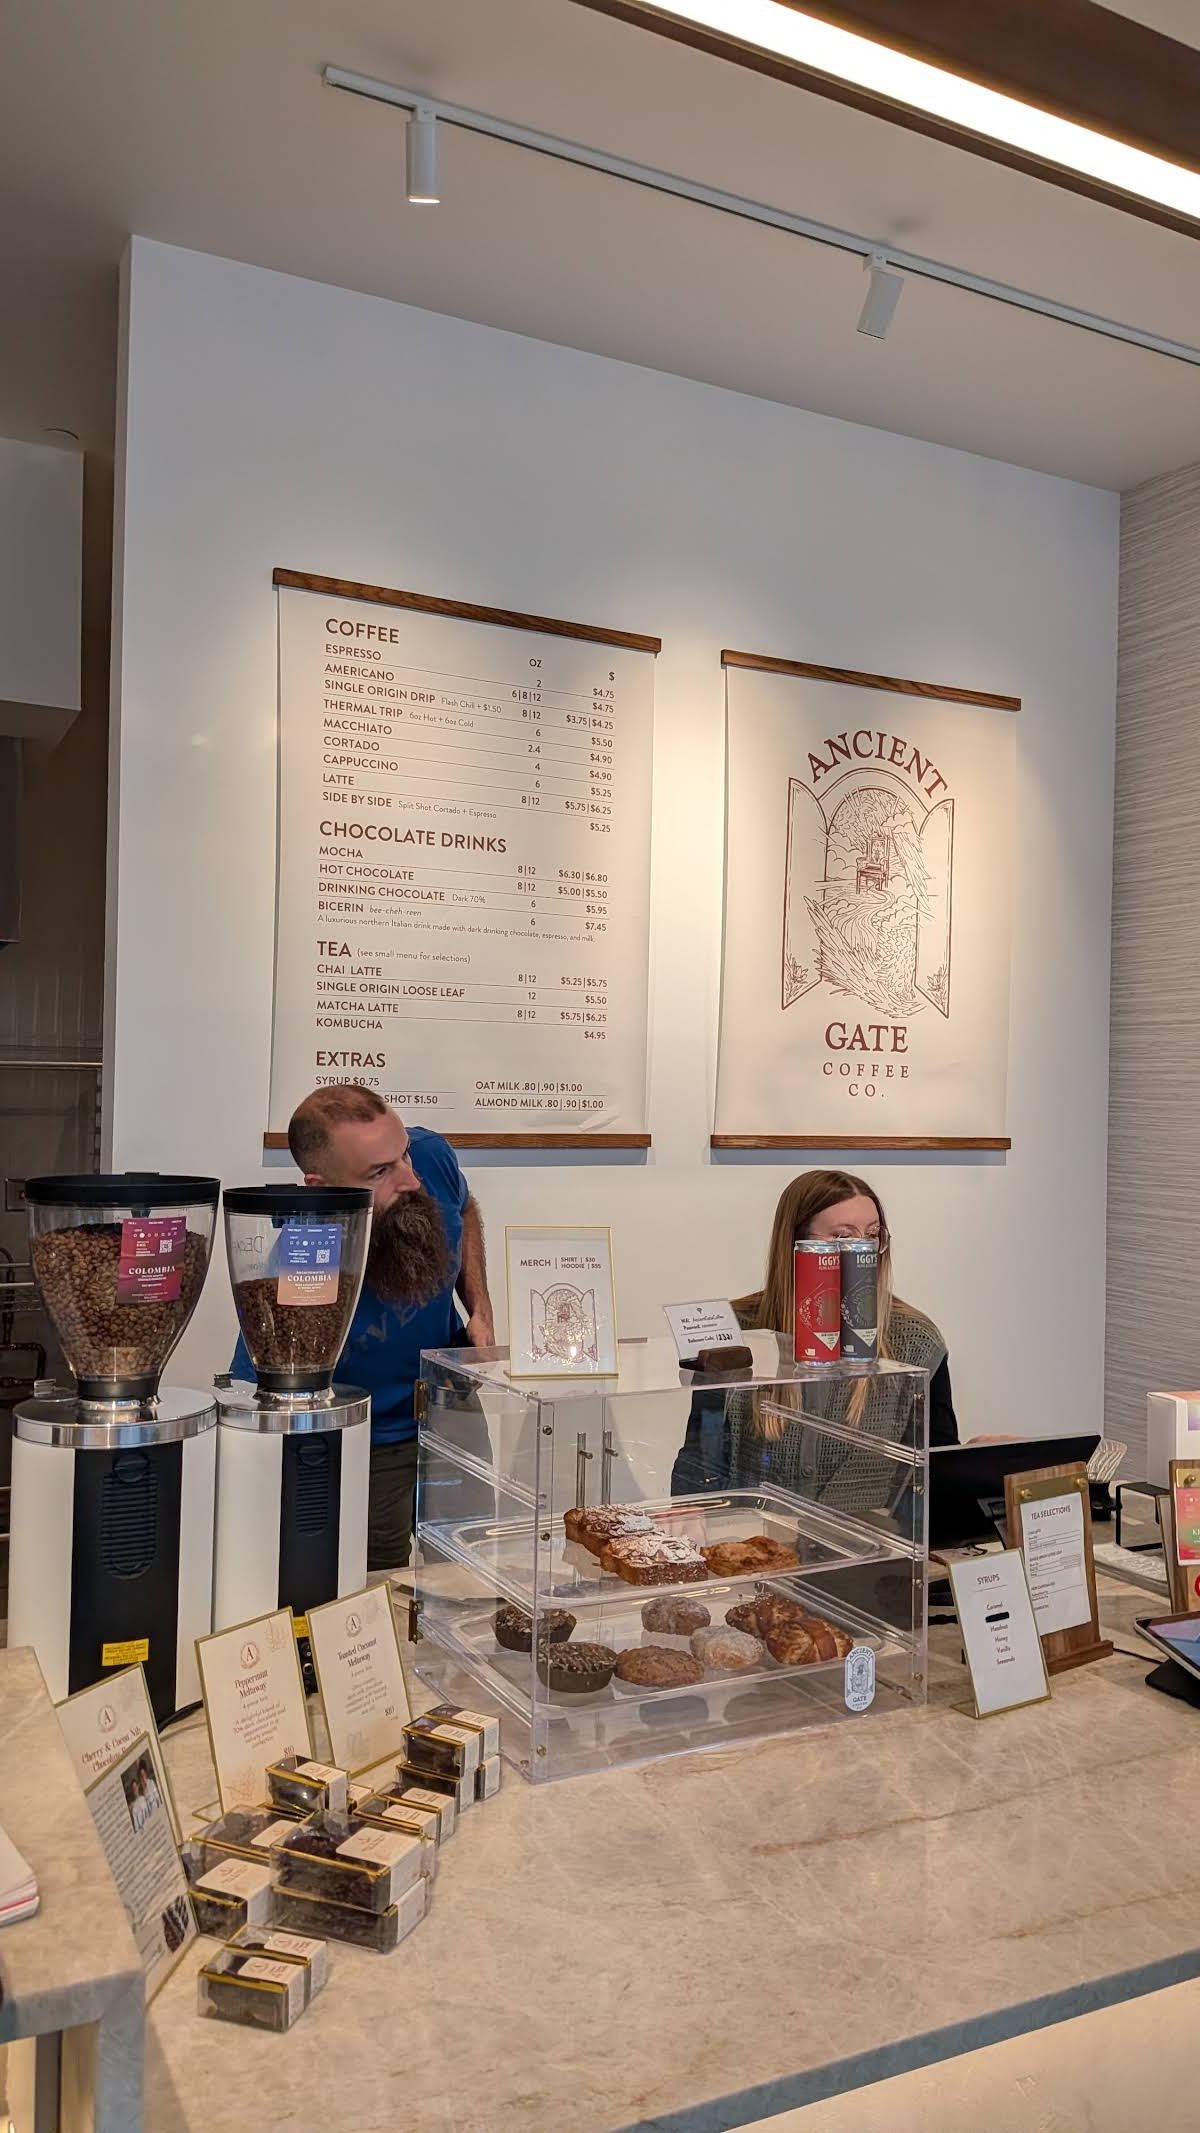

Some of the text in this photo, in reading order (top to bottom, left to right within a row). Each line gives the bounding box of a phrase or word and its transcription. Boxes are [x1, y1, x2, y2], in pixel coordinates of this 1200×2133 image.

[326, 618, 399, 644] COFFEE
[325, 644, 381, 660] ESPRESSO
[593, 688, 614, 699] $4.75
[529, 659, 542, 668] OZ
[609, 672, 615, 681] $
[324, 663, 394, 681] AMERICANO
[592, 702, 614, 713] $4.75
[324, 680, 364, 694] SINGLE
[368, 686, 407, 700] ORIGIN
[411, 692, 435, 703] DRIP
[441, 698, 458, 708] Flash
[483, 704, 501, 713] $1.50
[323, 699, 376, 714] THERMAL
[380, 707, 402, 718] TRIP
[410, 712, 421, 720] 6oz
[424, 714, 436, 722] Hot
[445, 717, 456, 726] 6oz
[459, 718, 473, 727] Cold
[592, 737, 613, 747] $5.50
[323, 718, 612, 764] MACCHIATO 2.4 $4.90
[323, 736, 380, 751] CORTADO
[590, 770, 612, 781] $4.90
[807, 730, 948, 798] ANCIENT
[323, 754, 612, 798] CAPPUCCINO 6 $5.25
[323, 773, 354, 785] LATTE
[323, 792, 347, 803] SIDE
[351, 795, 364, 804] BY
[368, 797, 392, 807] SIDE
[398, 800, 414, 810] Split
[416, 802, 431, 810] Shot
[433, 805, 460, 814] Cortado
[469, 809, 497, 819] Espresso
[590, 823, 610, 833] $5.25
[320, 821, 506, 853] CHOCOLATE DRINKS
[319, 846, 363, 858] MOCHA
[319, 864, 343, 874] HOT
[346, 867, 414, 880] CHOCOLATE
[318, 883, 607, 915] DRINKING CHOCOLATE Dark 70% 6 $5.95
[318, 901, 364, 912] BICERIN
[531, 918, 535, 926] 6
[585, 921, 606, 932] $7.45
[326, 916, 357, 924] luxurious
[359, 918, 389, 927] northern
[392, 920, 412, 928] Italian
[414, 922, 430, 930] drink
[432, 923, 450, 931] made
[452, 924, 466, 932] with
[468, 925, 481, 933] dark
[483, 928, 508, 937] drinking
[510, 930, 540, 939] chocolate,
[542, 933, 568, 941] espresso,
[317, 941, 352, 957] TEA
[358, 948, 373, 958] (see
[375, 950, 394, 958] small
[420, 952, 430, 960] for
[432, 954, 471, 964] selections)
[317, 964, 344, 974] CHAI
[351, 966, 382, 976] LATTE
[316, 982, 607, 1005] SINGLE ORIGIN LOOSE LEAF 12 $5.50
[316, 1001, 364, 1012] MATCHA
[368, 1003, 398, 1013] LATTE
[316, 1018, 606, 1040] KOMBUCHA $4.95
[825, 1022, 909, 1053] GATE
[316, 1051, 386, 1067] EXTRAS
[823, 1062, 909, 1078] COFFEE
[316, 1076, 379, 1086] SYRUP $0.75
[476, 1082, 495, 1090] OAT
[498, 1082, 520, 1091] MILK
[848, 1084, 884, 1097] CO.
[384, 1095, 438, 1104] SHOT $1.50
[475, 1098, 517, 1107] ALMOND
[520, 1099, 542, 1107] MILK
[129, 1266, 176, 1275] COLOMBIA
[520, 1259, 551, 1267] MERCH
[1031, 1505, 1071, 1520] TEA SELECTIONS
[977, 1574, 1000, 1585] SYRUPS
[358, 1638, 376, 1652] Coconut
[850, 1648, 872, 1658] ANCIENT
[348, 1654, 370, 1667] Meltaway
[234, 1670, 268, 1688] Peppermint
[240, 1682, 267, 1697] Meltaway
[82, 1748, 104, 1764] Cherry
